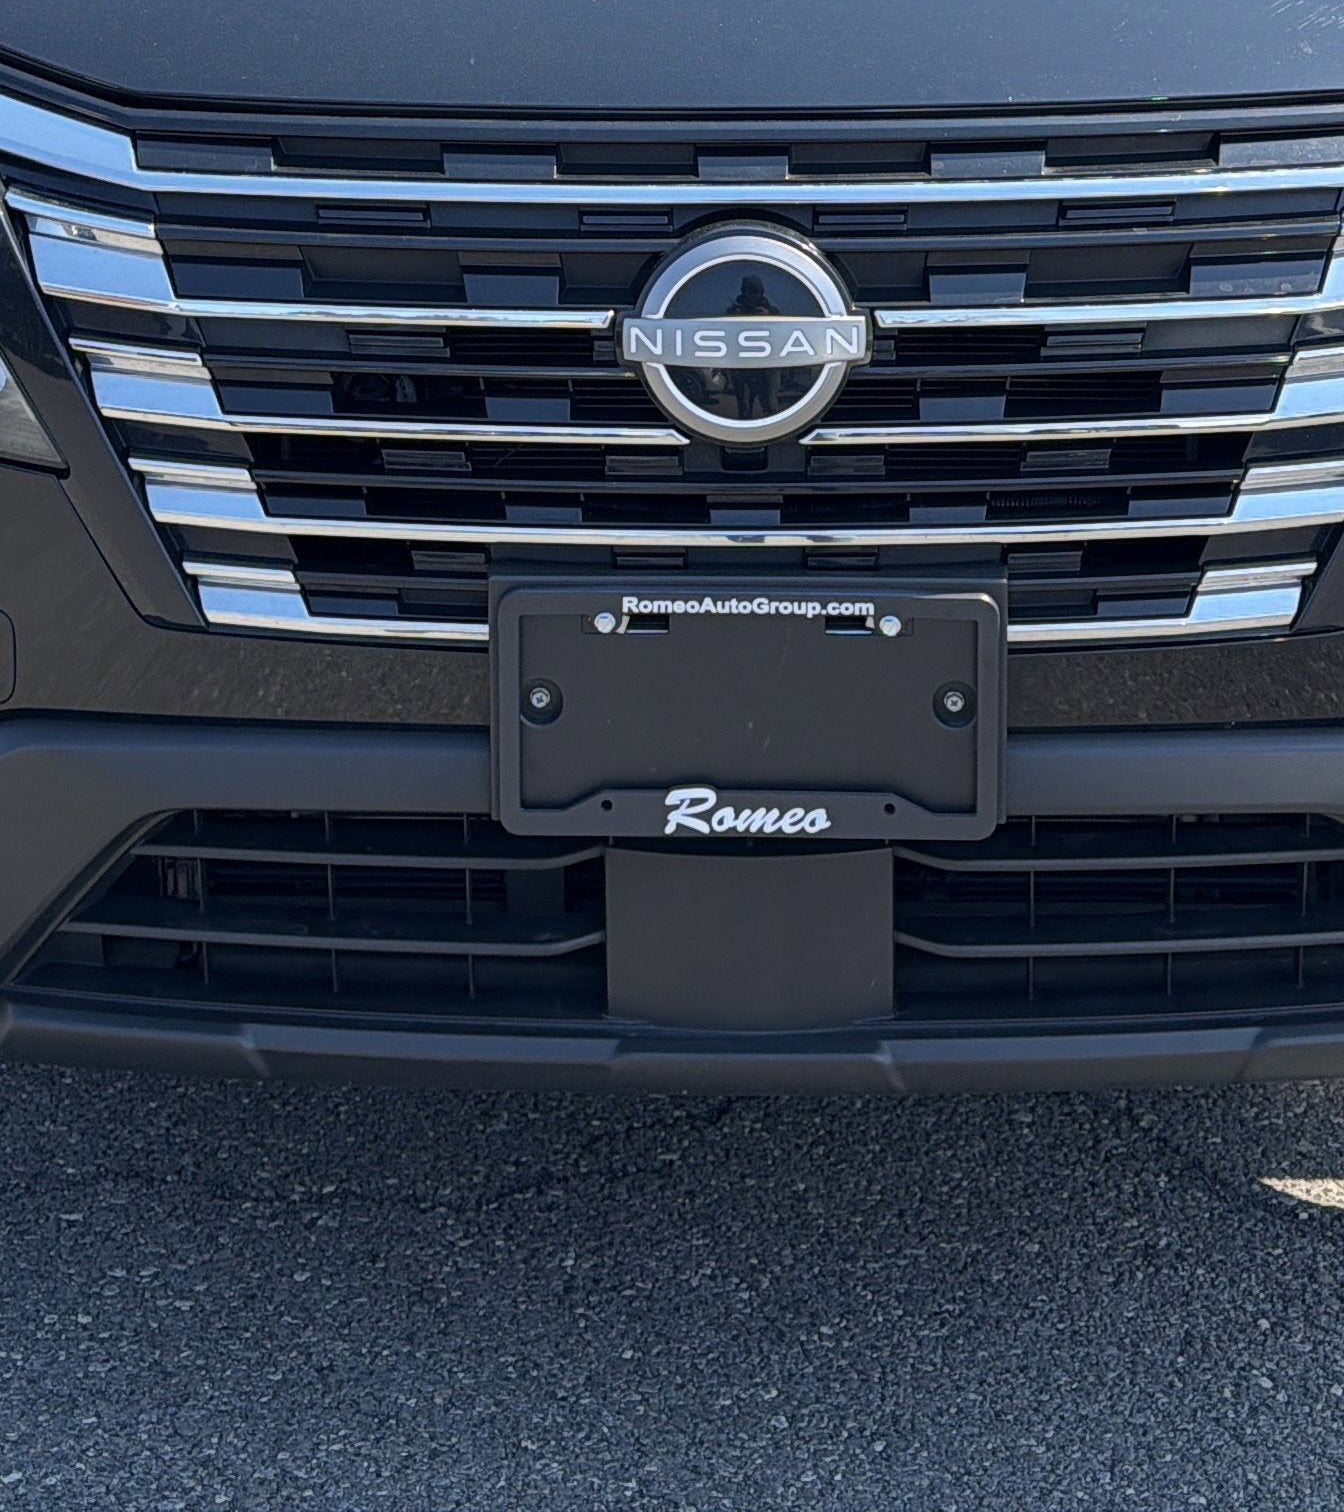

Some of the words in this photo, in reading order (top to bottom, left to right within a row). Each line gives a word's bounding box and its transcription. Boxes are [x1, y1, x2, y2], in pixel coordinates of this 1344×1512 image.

[630, 327, 857, 358] NISSAN
[622, 596, 875, 618] RomeoAutoGroup.com
[664, 787, 832, 835] Romeo
